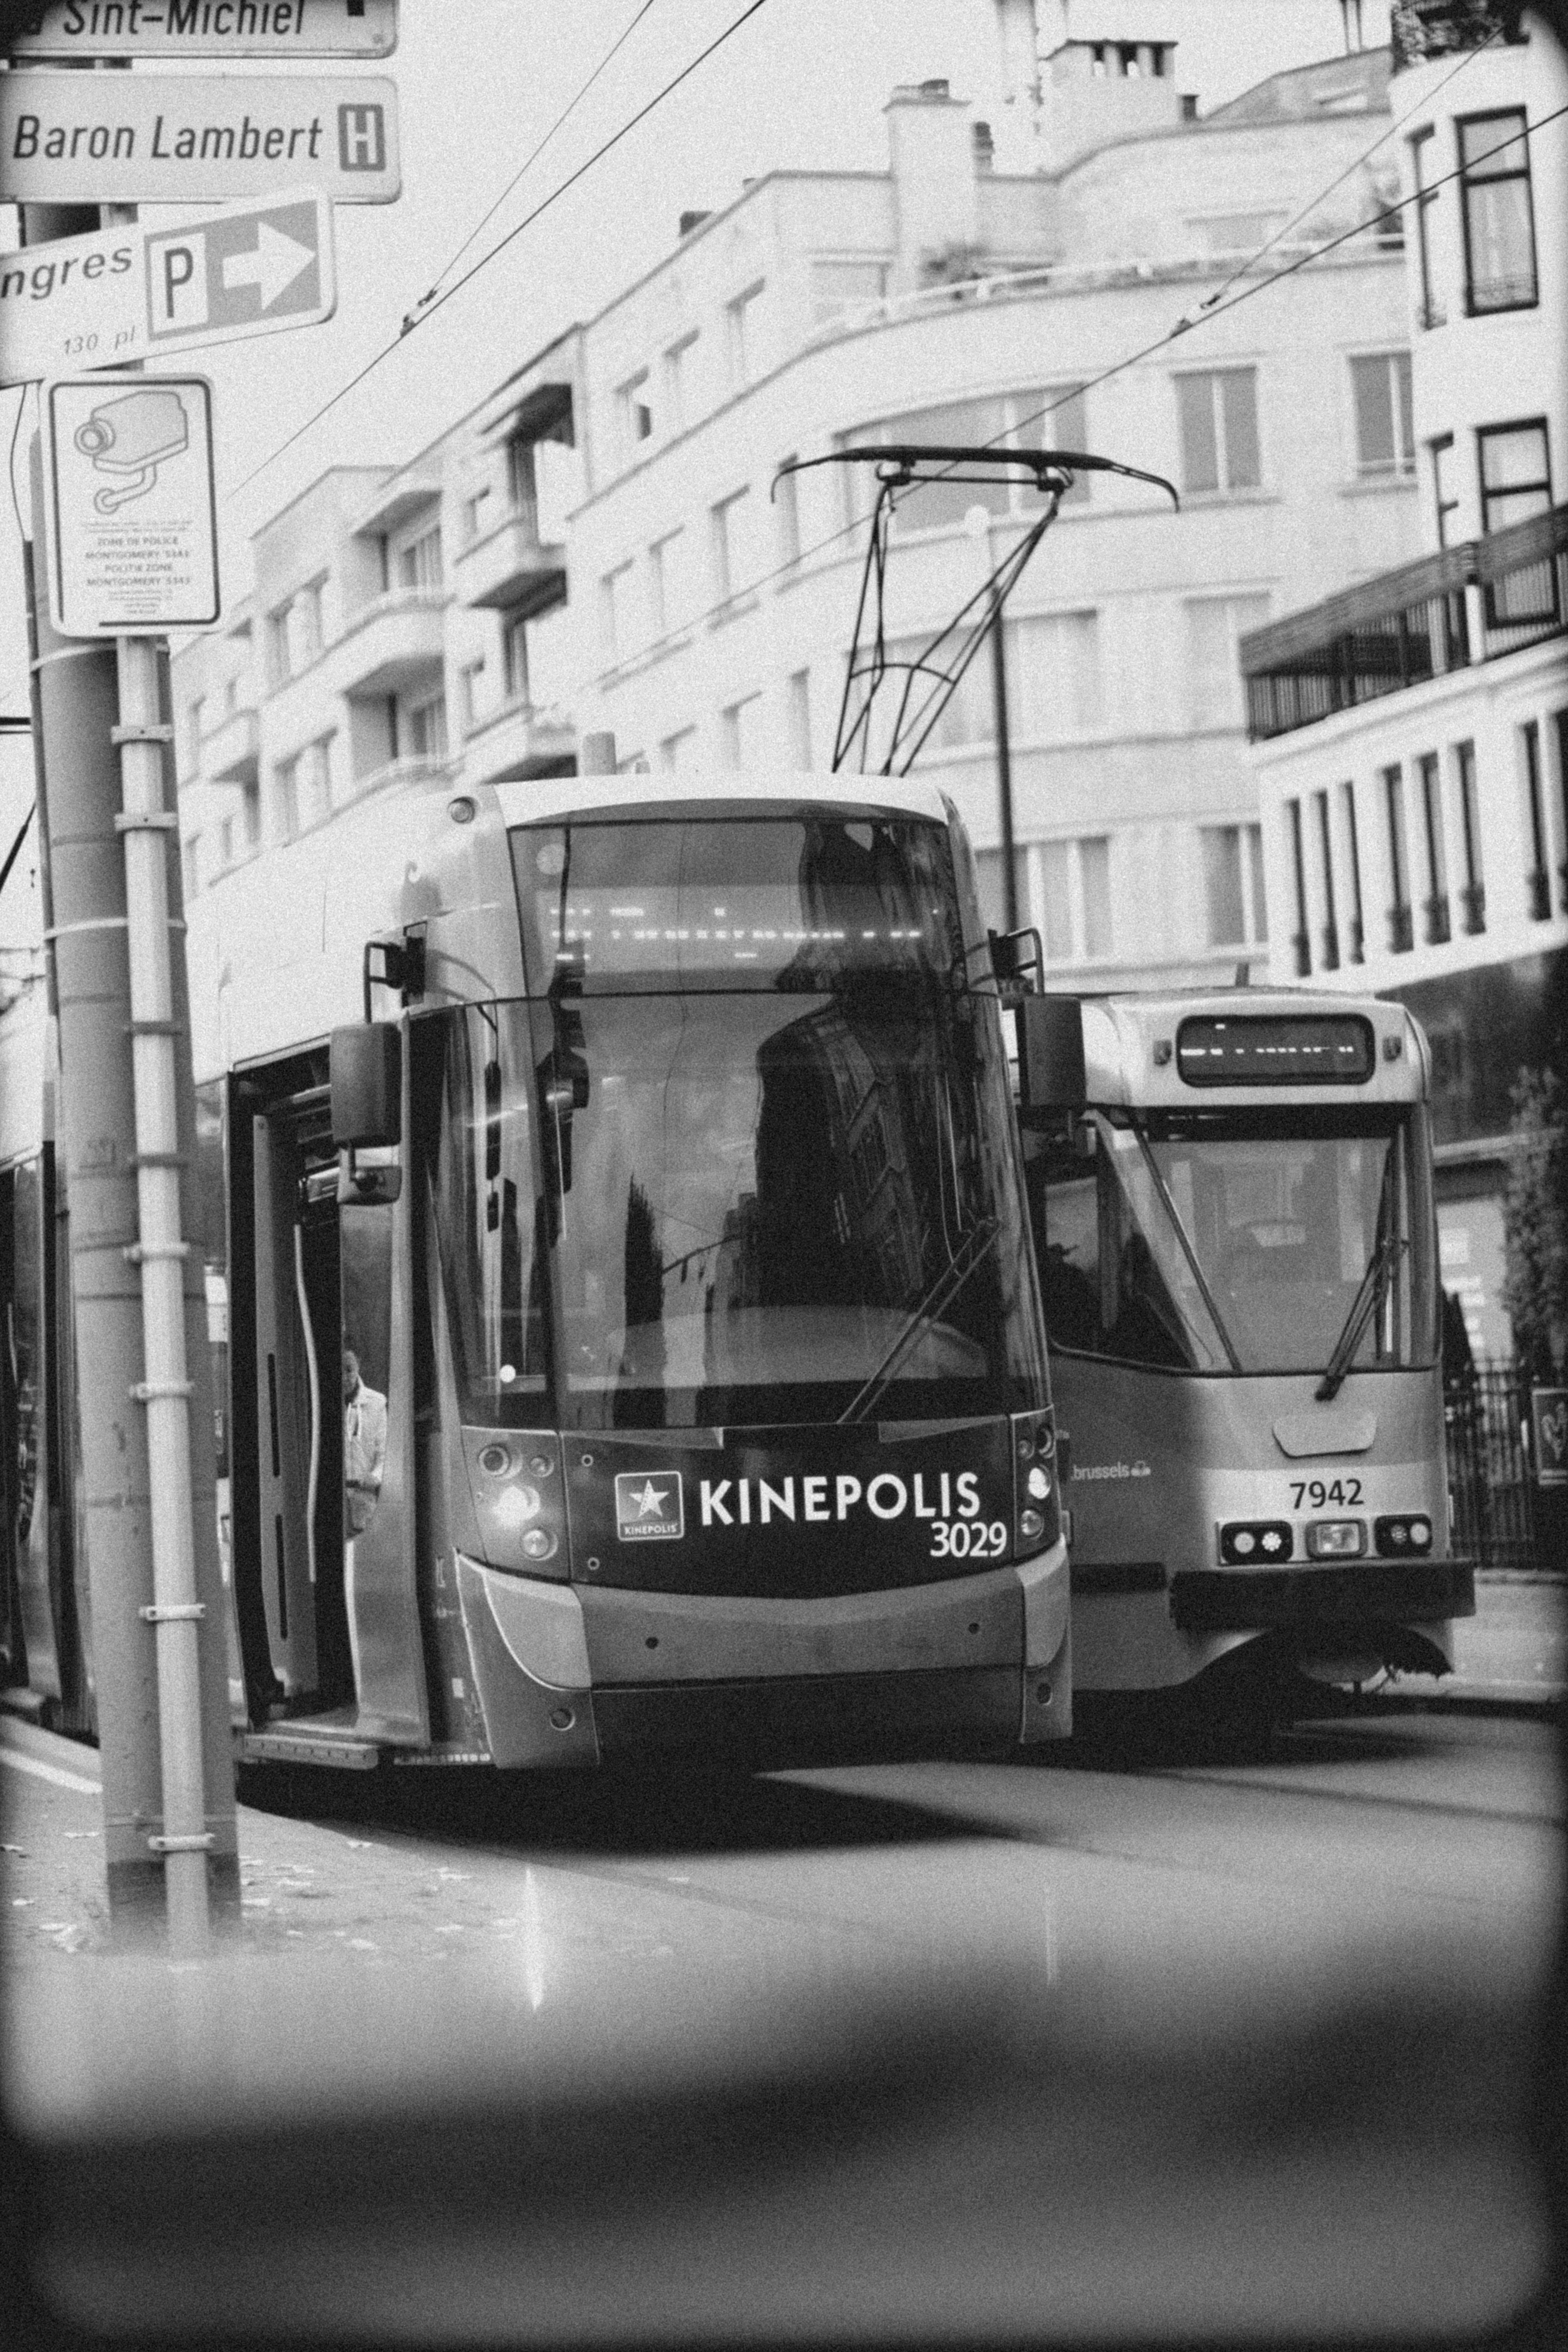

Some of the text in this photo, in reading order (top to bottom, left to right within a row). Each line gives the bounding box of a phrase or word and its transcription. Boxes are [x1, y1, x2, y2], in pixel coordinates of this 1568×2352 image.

[63, 0, 305, 35] Sint-Michiel
[13, 110, 377, 165] Baron Lambert H
[164, 247, 194, 319] P
[64, 325, 135, 354] 130 pl
[85, 550, 160, 559] MONTGOMERY
[98, 536, 178, 546] ZONE DE POLICE
[87, 577, 161, 586] MONTGOMERY
[105, 563, 173, 573] POLITIE ZONE
[700, 1472, 981, 1526] KINEPOLIS
[1289, 1479, 1365, 1509] 7942
[624, 1523, 678, 1535] KINEPOLIS
[929, 1521, 1007, 1558] 3029
